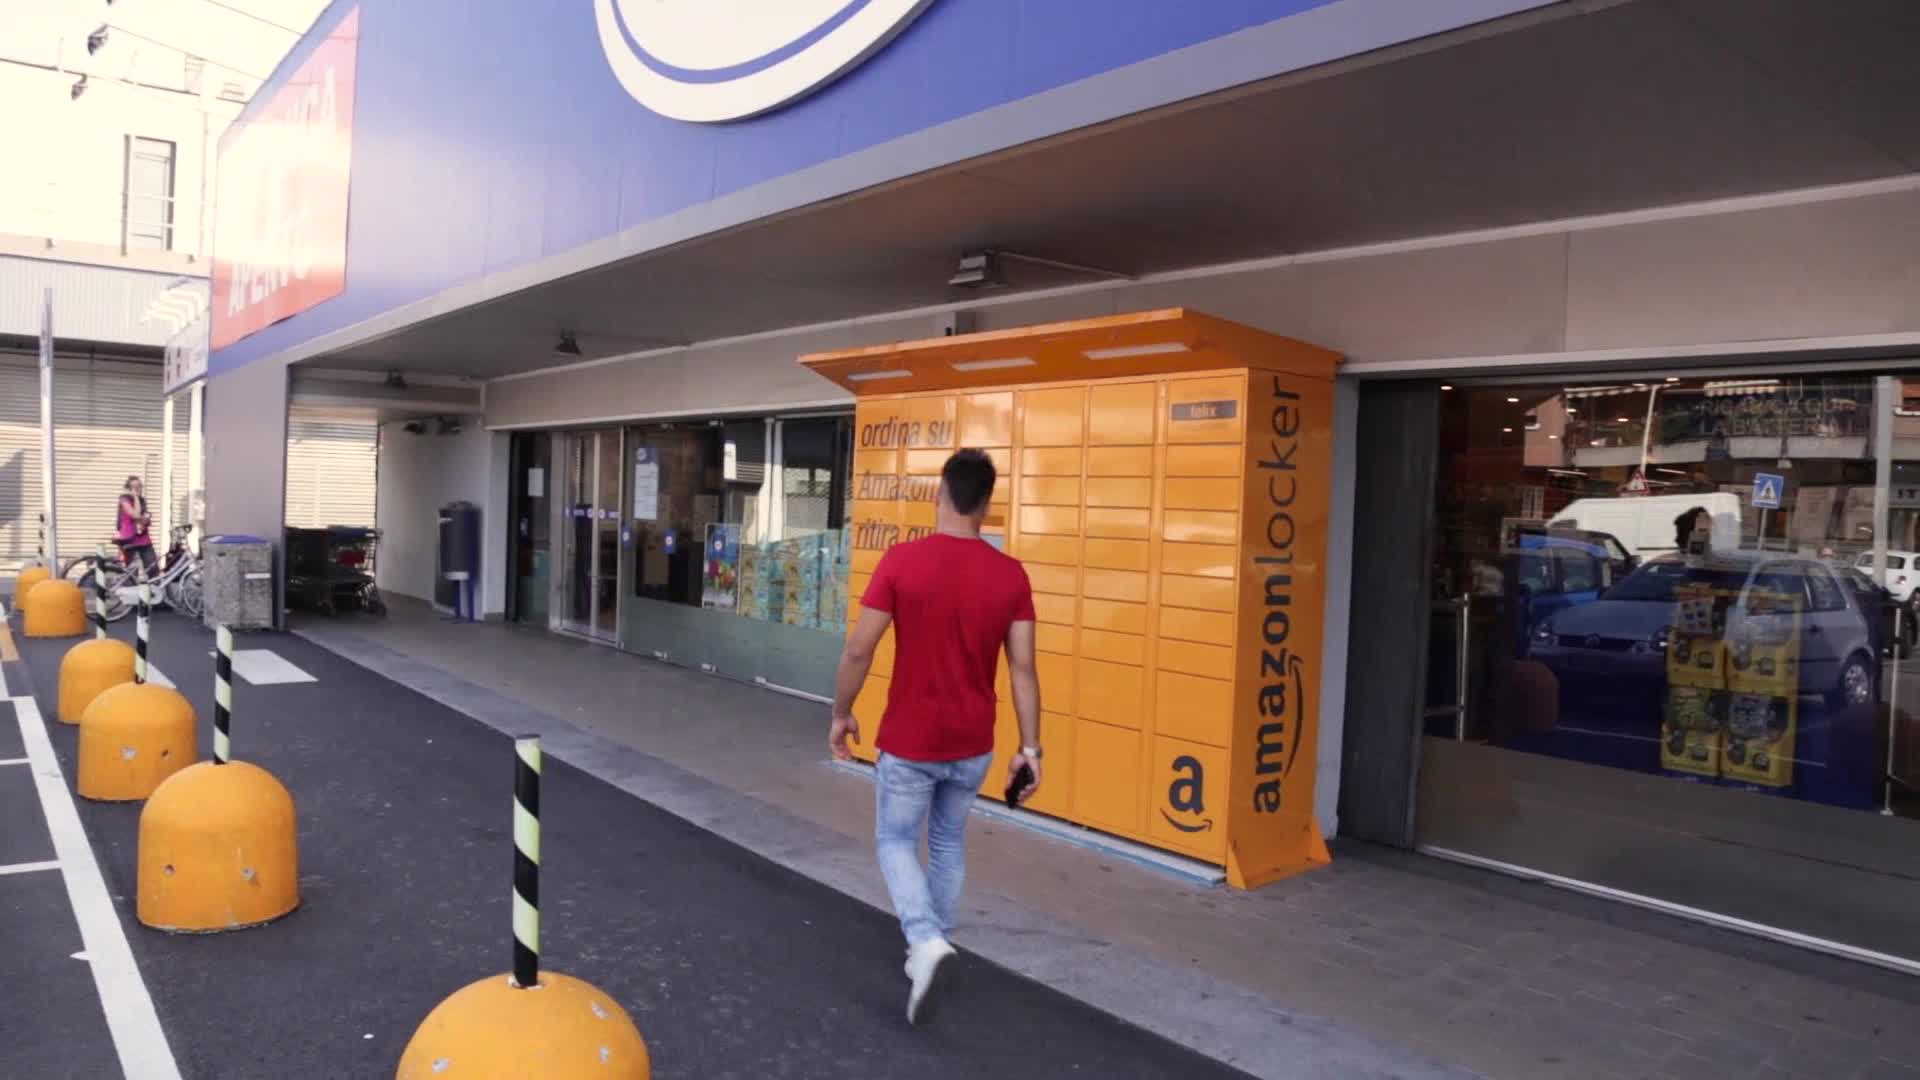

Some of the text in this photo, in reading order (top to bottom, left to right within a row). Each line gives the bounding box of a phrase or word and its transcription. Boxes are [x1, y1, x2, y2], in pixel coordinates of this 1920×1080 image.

[861, 415, 953, 448] ordina su
[859, 470, 936, 500] Amazon
[856, 518, 899, 551] ritira
[1253, 376, 1303, 814] amazonlocker
[1167, 754, 1206, 818] a
